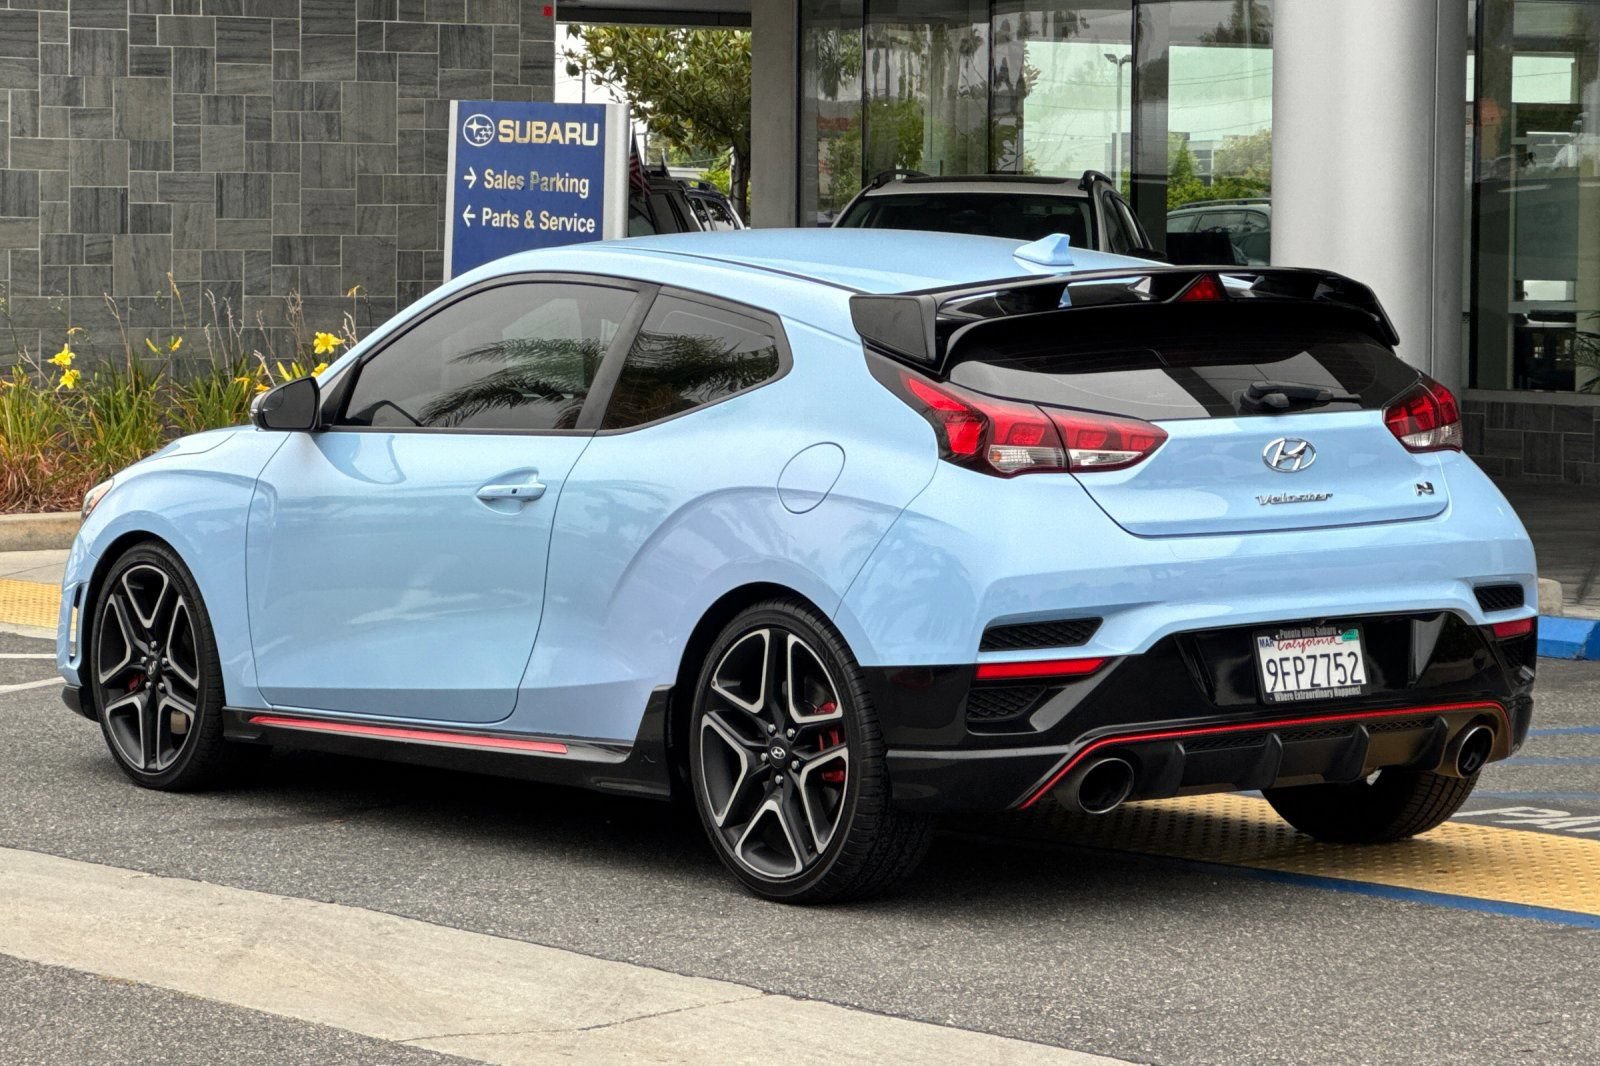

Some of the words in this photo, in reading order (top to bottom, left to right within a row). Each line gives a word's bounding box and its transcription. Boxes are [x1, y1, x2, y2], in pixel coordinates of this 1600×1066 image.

[498, 119, 599, 146] SUBARU
[483, 168, 525, 190] Sales
[529, 170, 589, 199] Parking
[482, 207, 520, 229] Parts
[523, 209, 535, 230] &
[539, 210, 596, 233] Service
[1414, 481, 1434, 496] N
[1276, 636, 1344, 653] California
[1266, 651, 1363, 692] 9FPZ752
